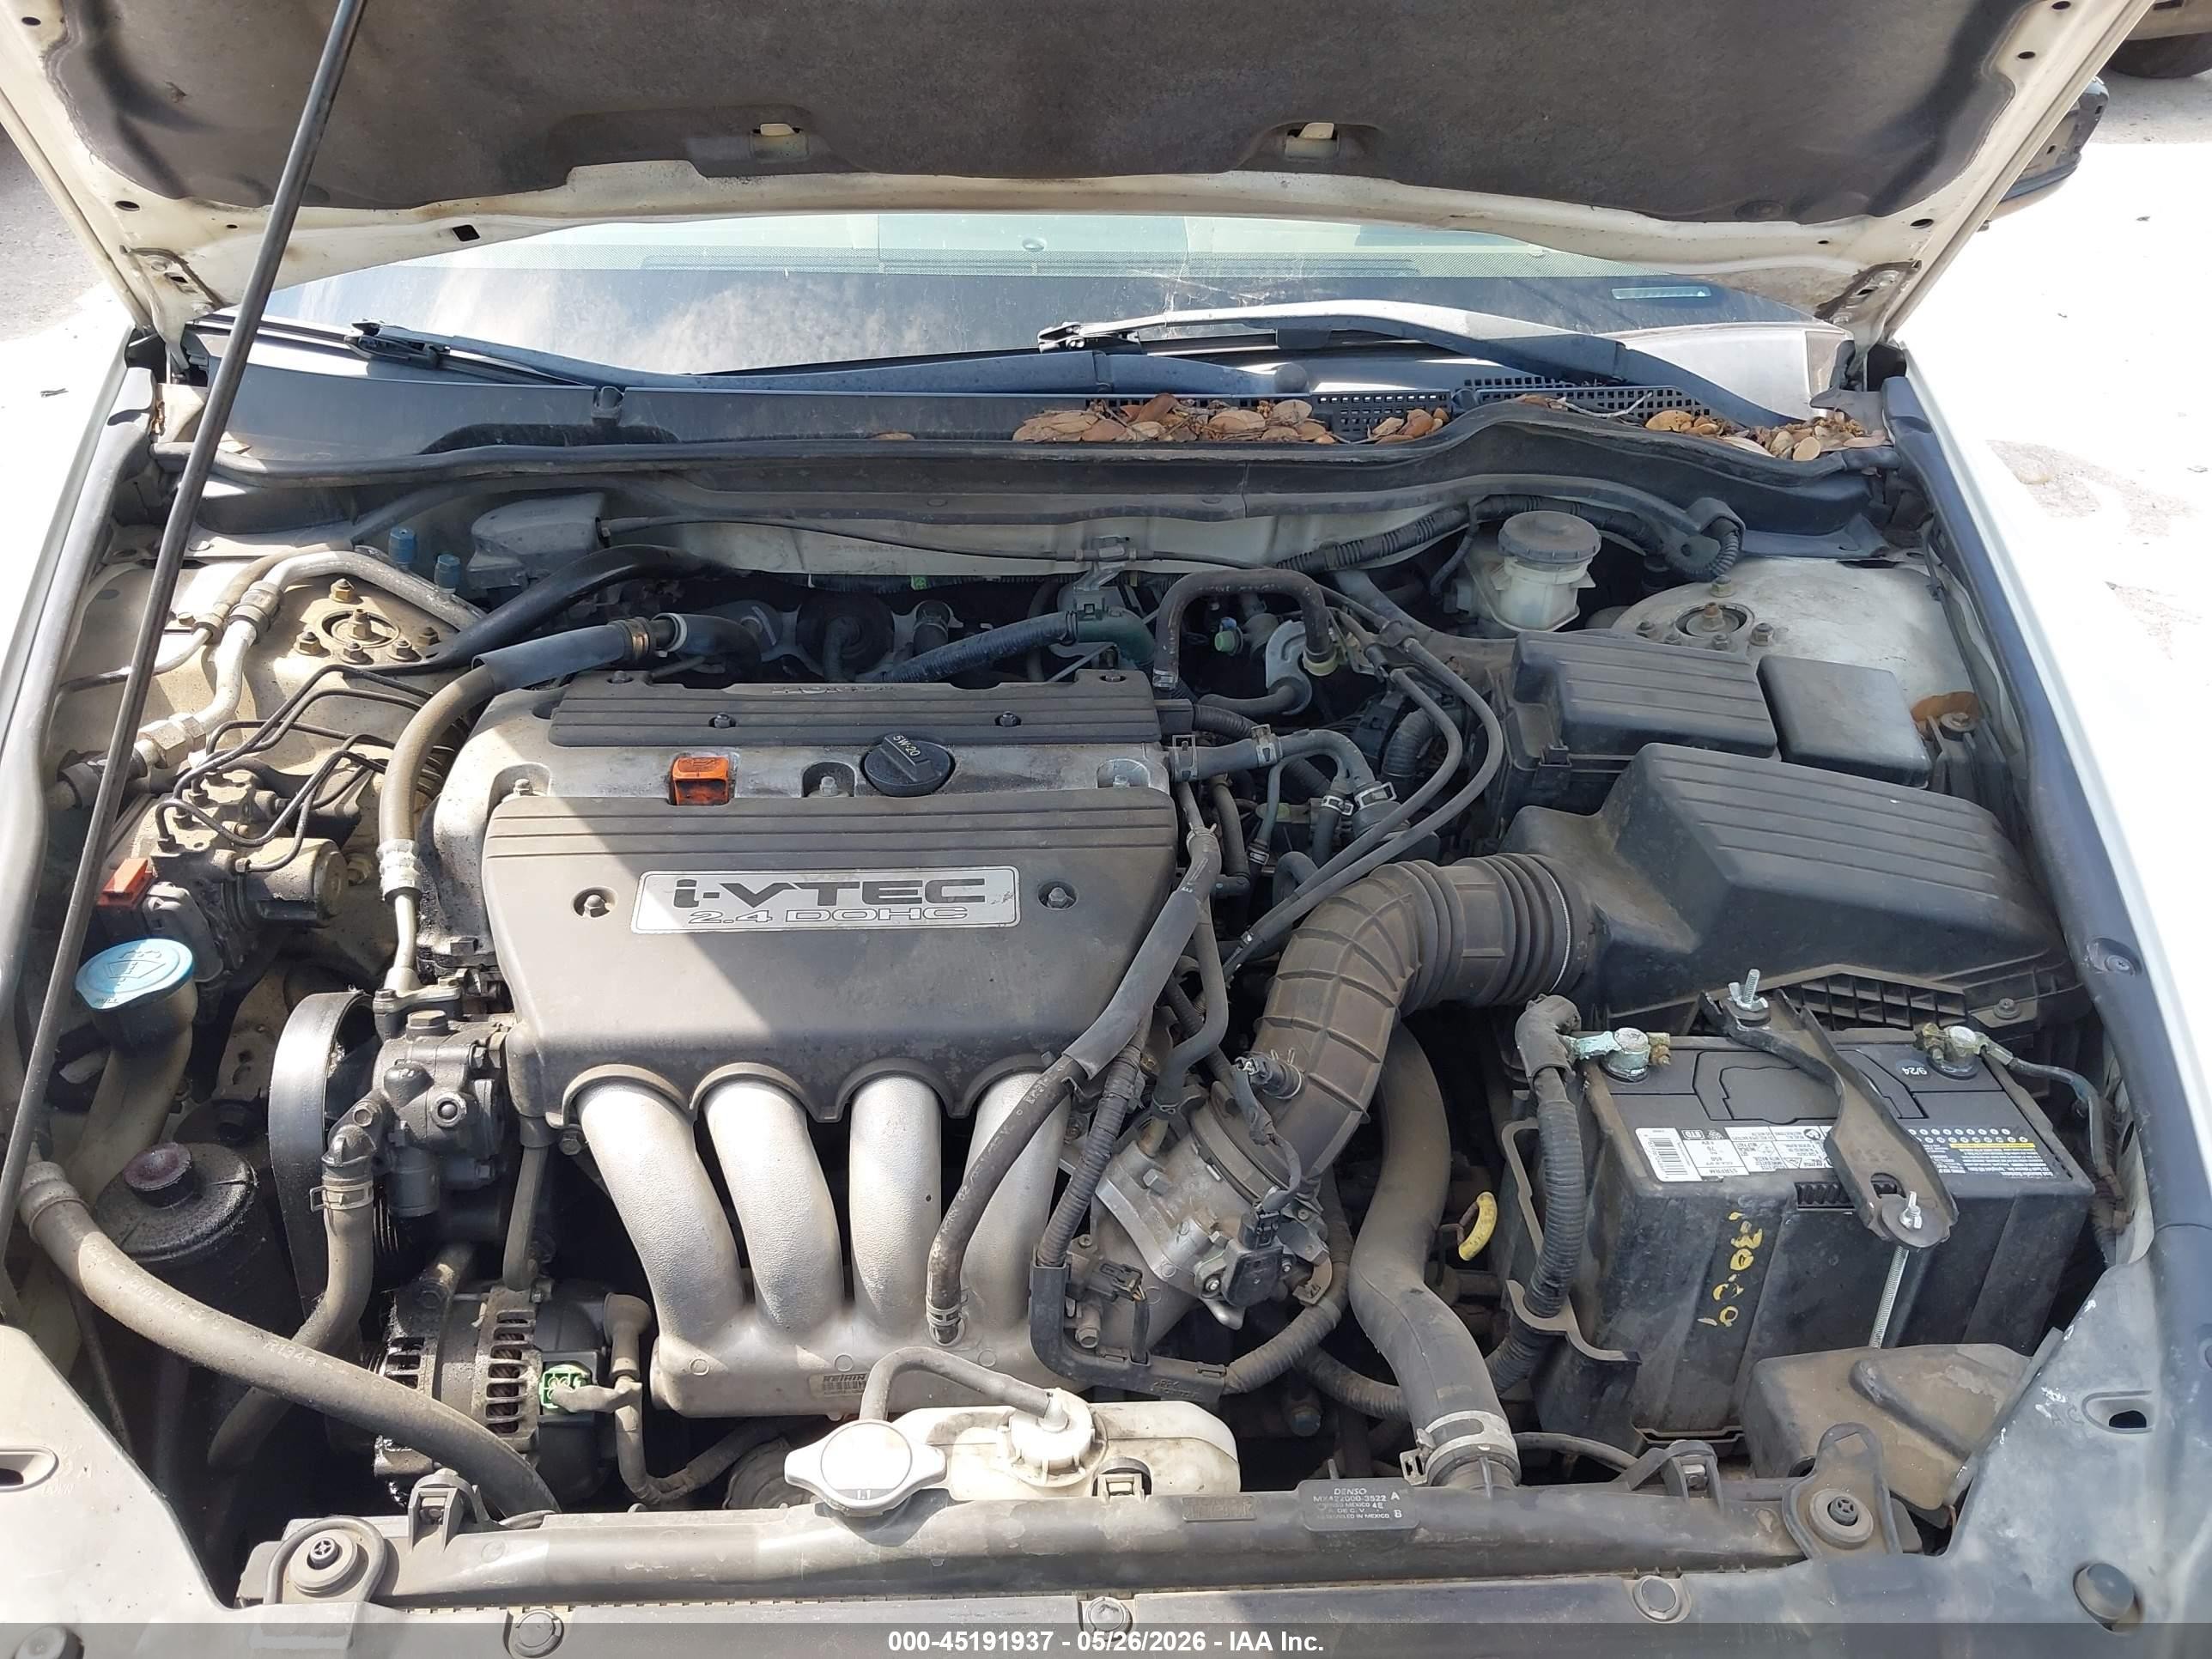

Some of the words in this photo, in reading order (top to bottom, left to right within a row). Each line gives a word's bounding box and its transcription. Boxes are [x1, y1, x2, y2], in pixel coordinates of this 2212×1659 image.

[893, 735, 921, 757] 5W-20
[674, 878, 986, 908] i-VTEC
[688, 910, 772, 924] 2.4
[785, 907, 968, 922] DOHC
[1901, 1066, 1929, 1075] 9/24
[1390, 1492, 1401, 1500] A
[1394, 1509, 1402, 1518] B
